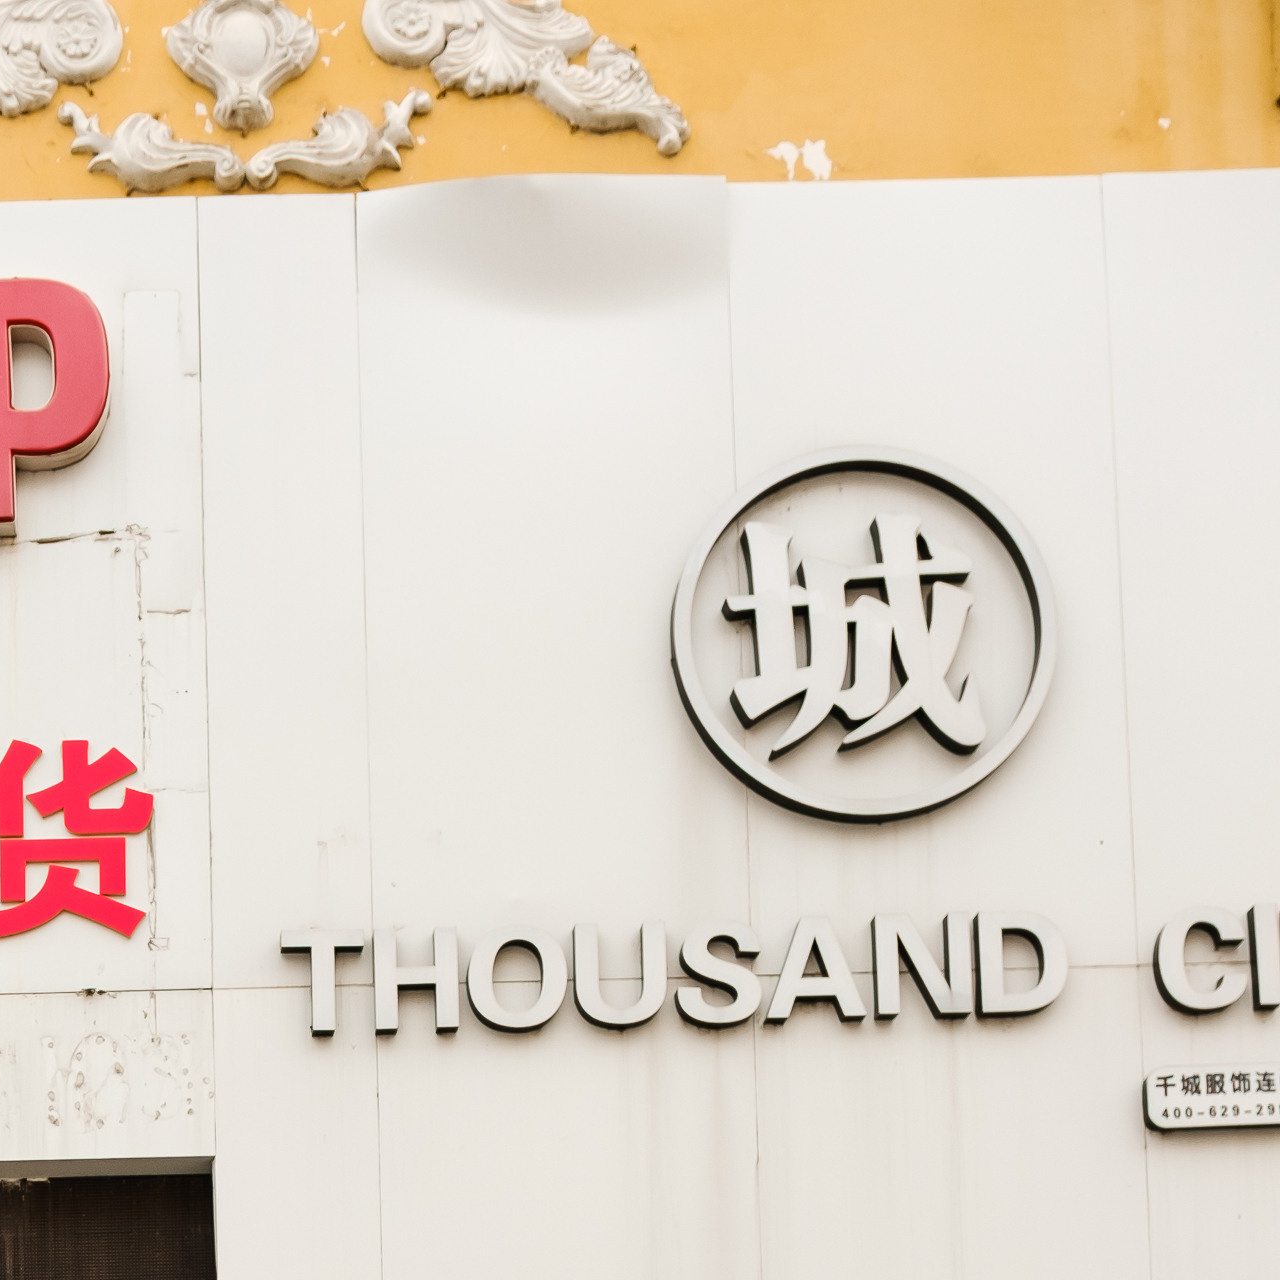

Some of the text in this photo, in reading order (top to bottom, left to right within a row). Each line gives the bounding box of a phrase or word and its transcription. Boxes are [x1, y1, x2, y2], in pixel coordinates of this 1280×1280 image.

[722, 513, 988, 760] 城
[280, 908, 1071, 1038] THOUSAND
[1161, 1104, 1280, 1119] 400-629-29
